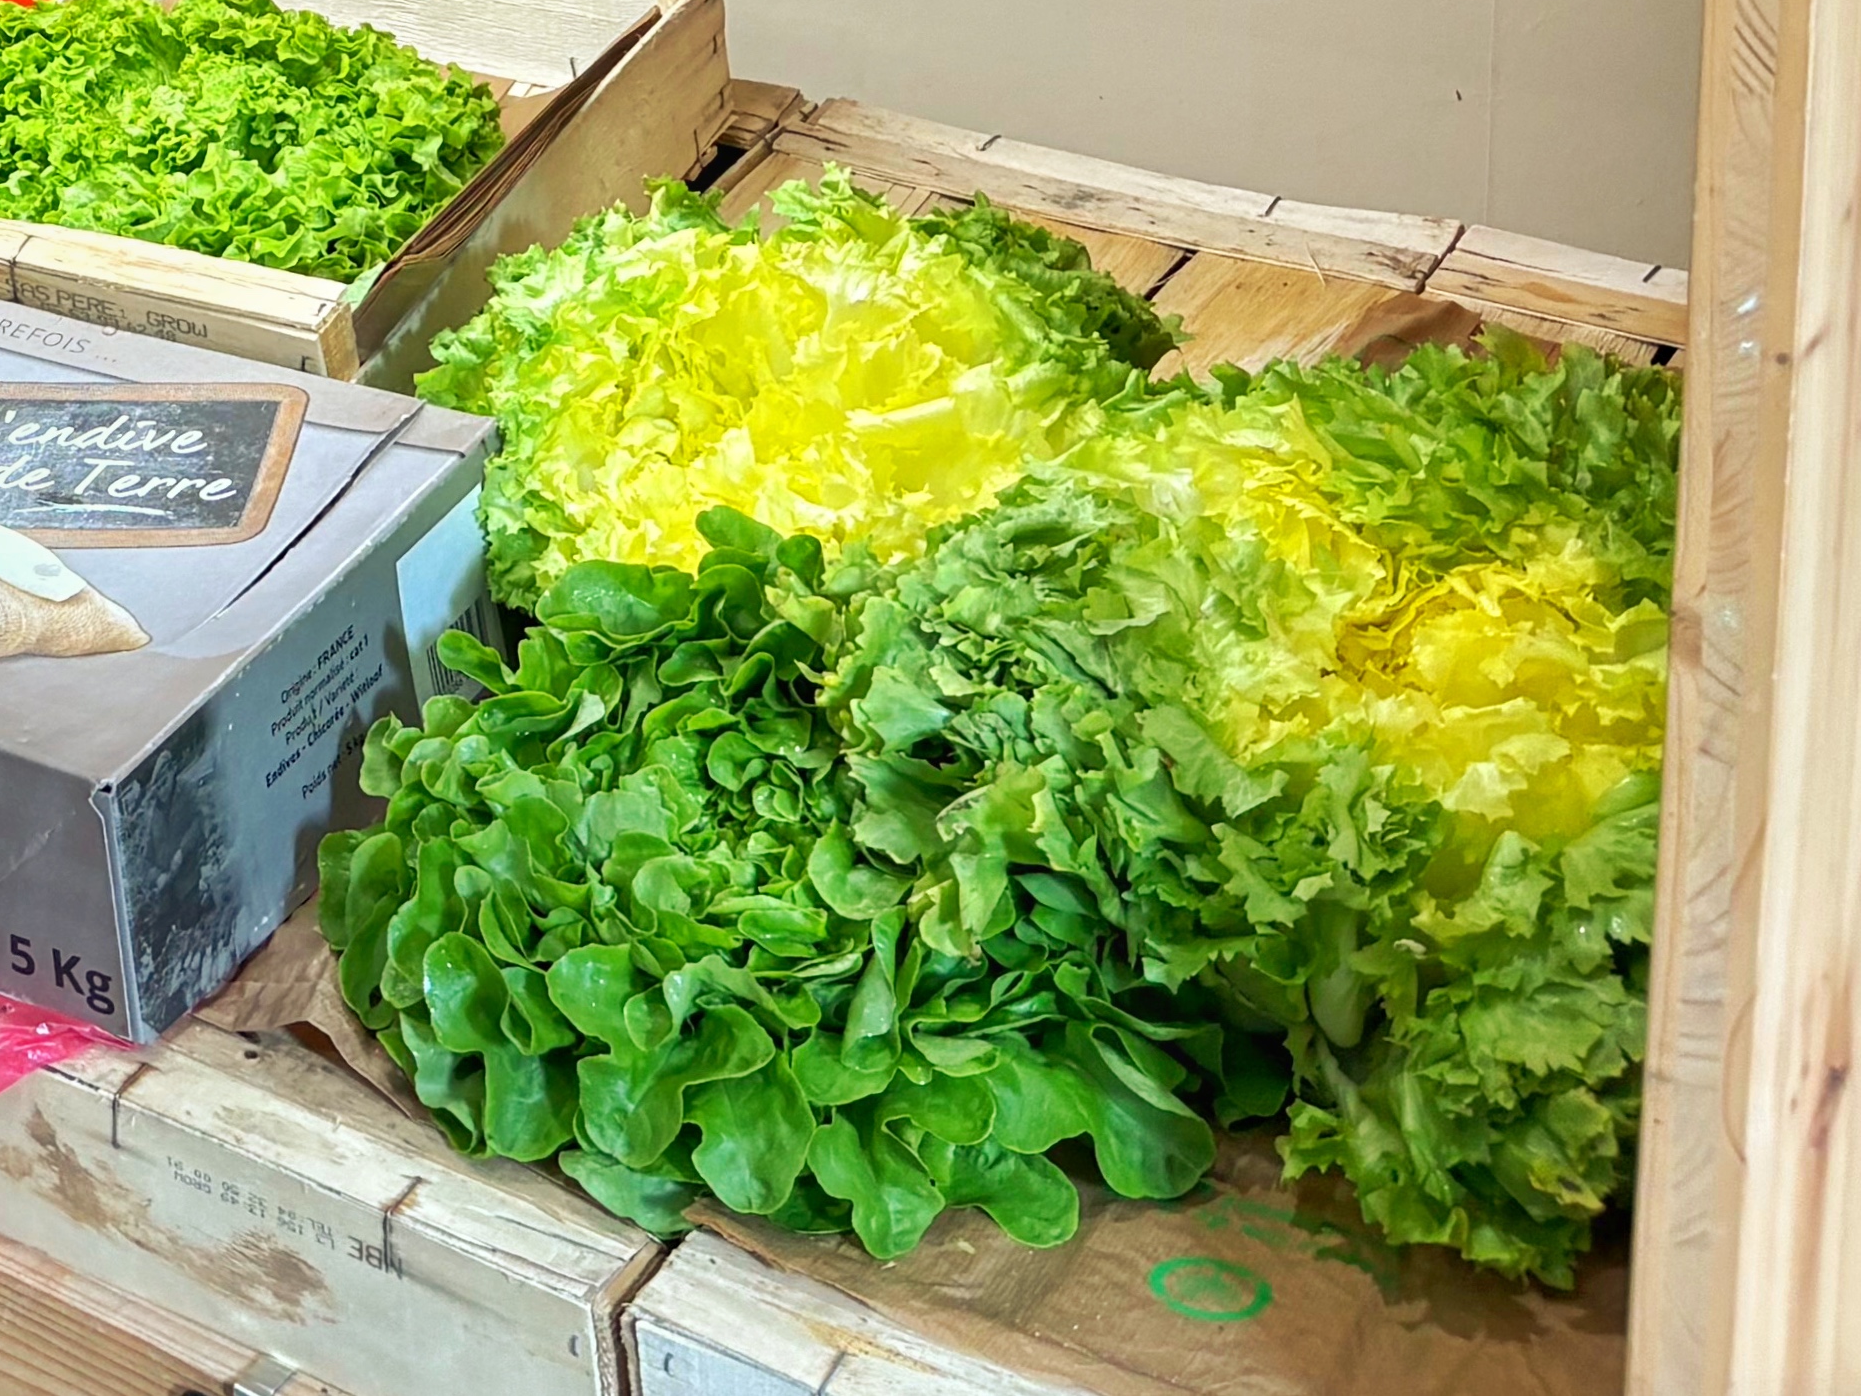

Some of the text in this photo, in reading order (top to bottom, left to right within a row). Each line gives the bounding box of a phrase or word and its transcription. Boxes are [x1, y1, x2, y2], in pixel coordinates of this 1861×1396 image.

[146, 311, 209, 340] GROW
[76, 456, 239, 502] Terre
[316, 624, 356, 671] FRANCE
[265, 749, 302, 789] Endives
[9, 933, 116, 1016] 5 Kg
